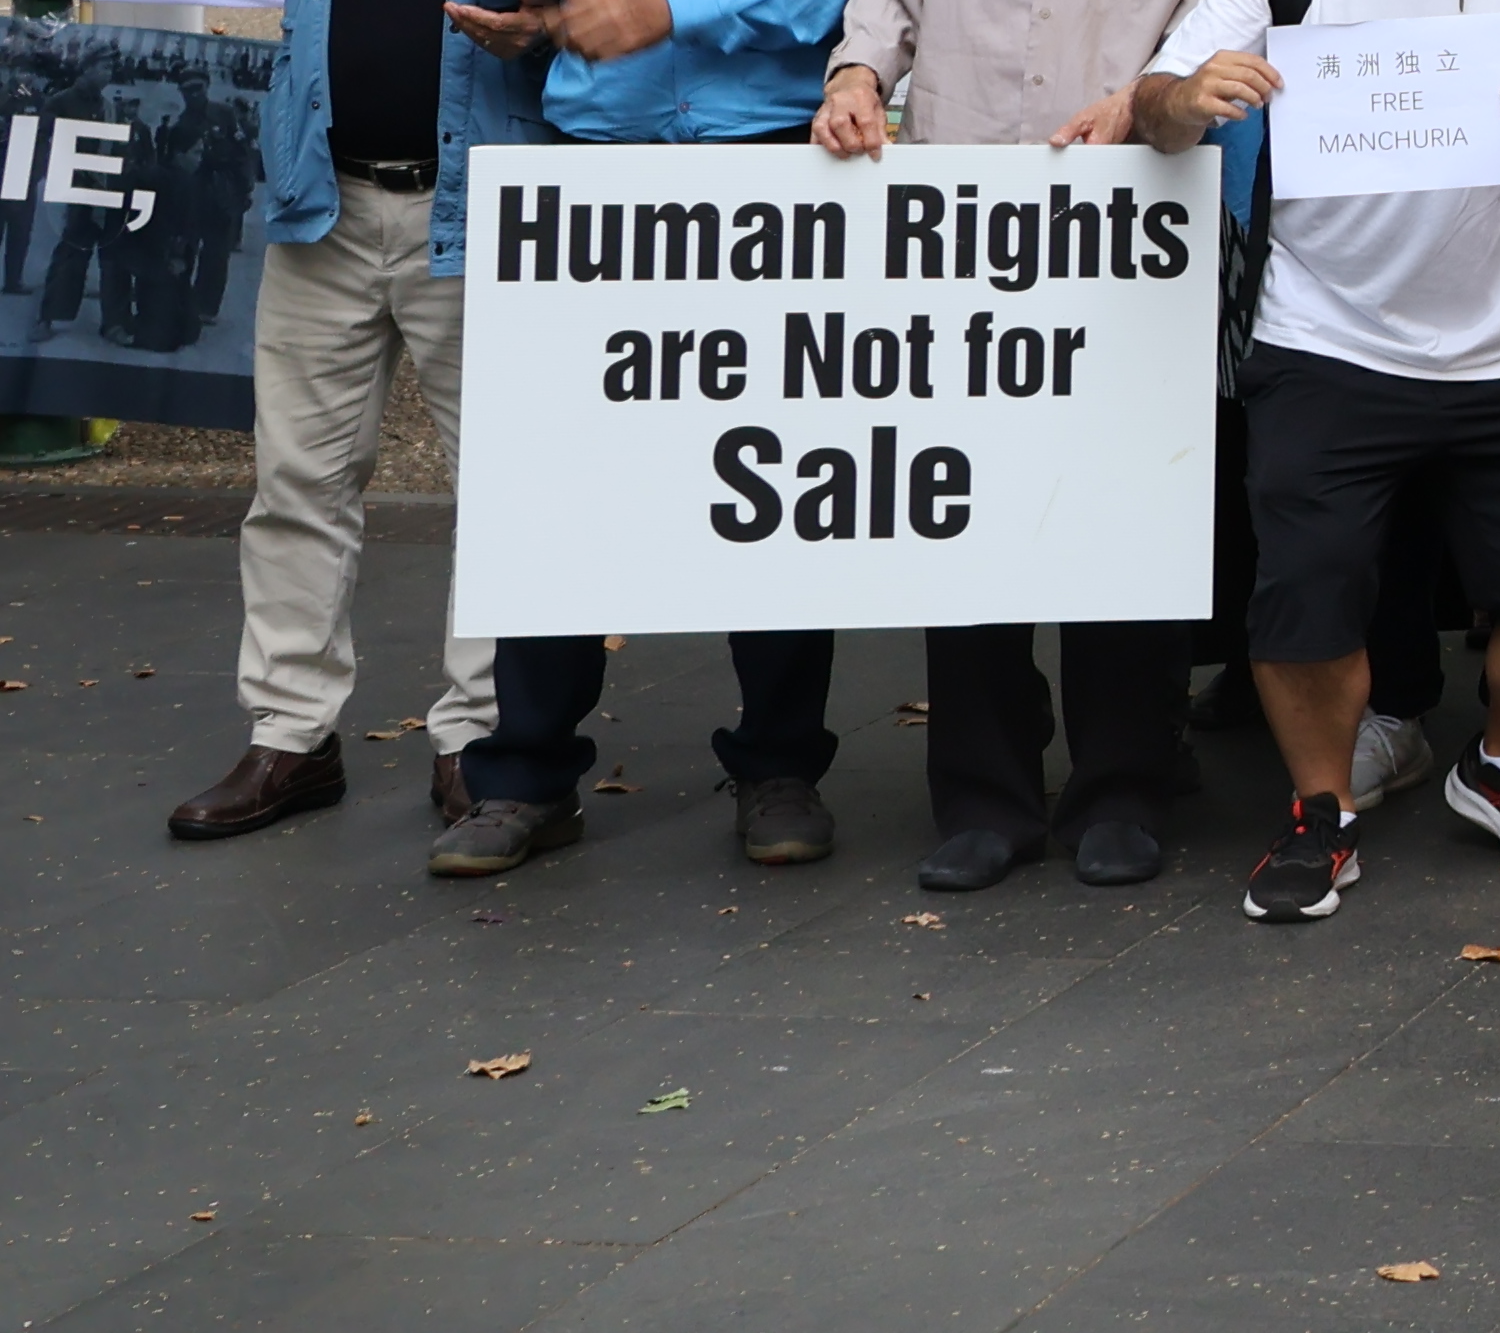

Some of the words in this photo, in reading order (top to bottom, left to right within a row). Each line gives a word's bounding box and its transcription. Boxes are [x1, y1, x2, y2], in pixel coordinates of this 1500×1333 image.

[1316, 48, 1460, 80] 满洲独立
[1370, 90, 1425, 113] FREE
[1319, 126, 1469, 154] MANCHURIA
[496, 184, 847, 283] Human
[884, 183, 1190, 293] Rights
[602, 326, 747, 402] are
[783, 311, 934, 400] Not
[964, 311, 1086, 398] for
[709, 424, 972, 544] Sale
